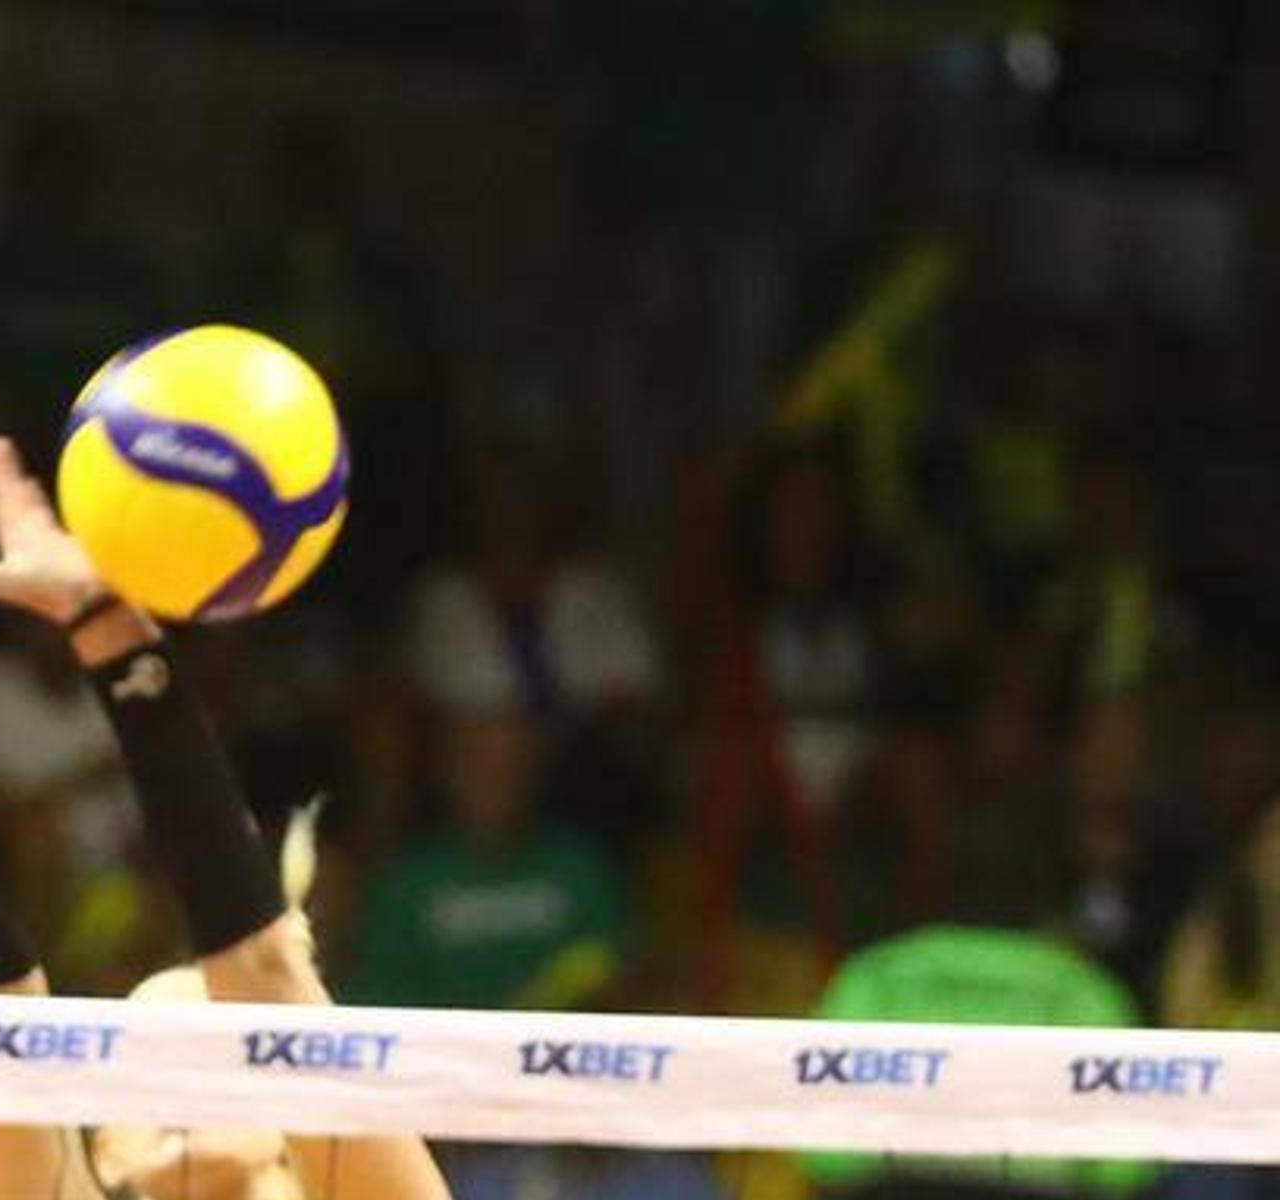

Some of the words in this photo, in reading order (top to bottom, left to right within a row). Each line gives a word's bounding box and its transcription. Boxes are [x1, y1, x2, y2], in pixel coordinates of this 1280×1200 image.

[242, 1030, 398, 1071] 1XBET
[518, 1039, 674, 1083] 1XBET
[793, 1047, 948, 1087] 1XBET
[1068, 1055, 1222, 1096] 1XBET
